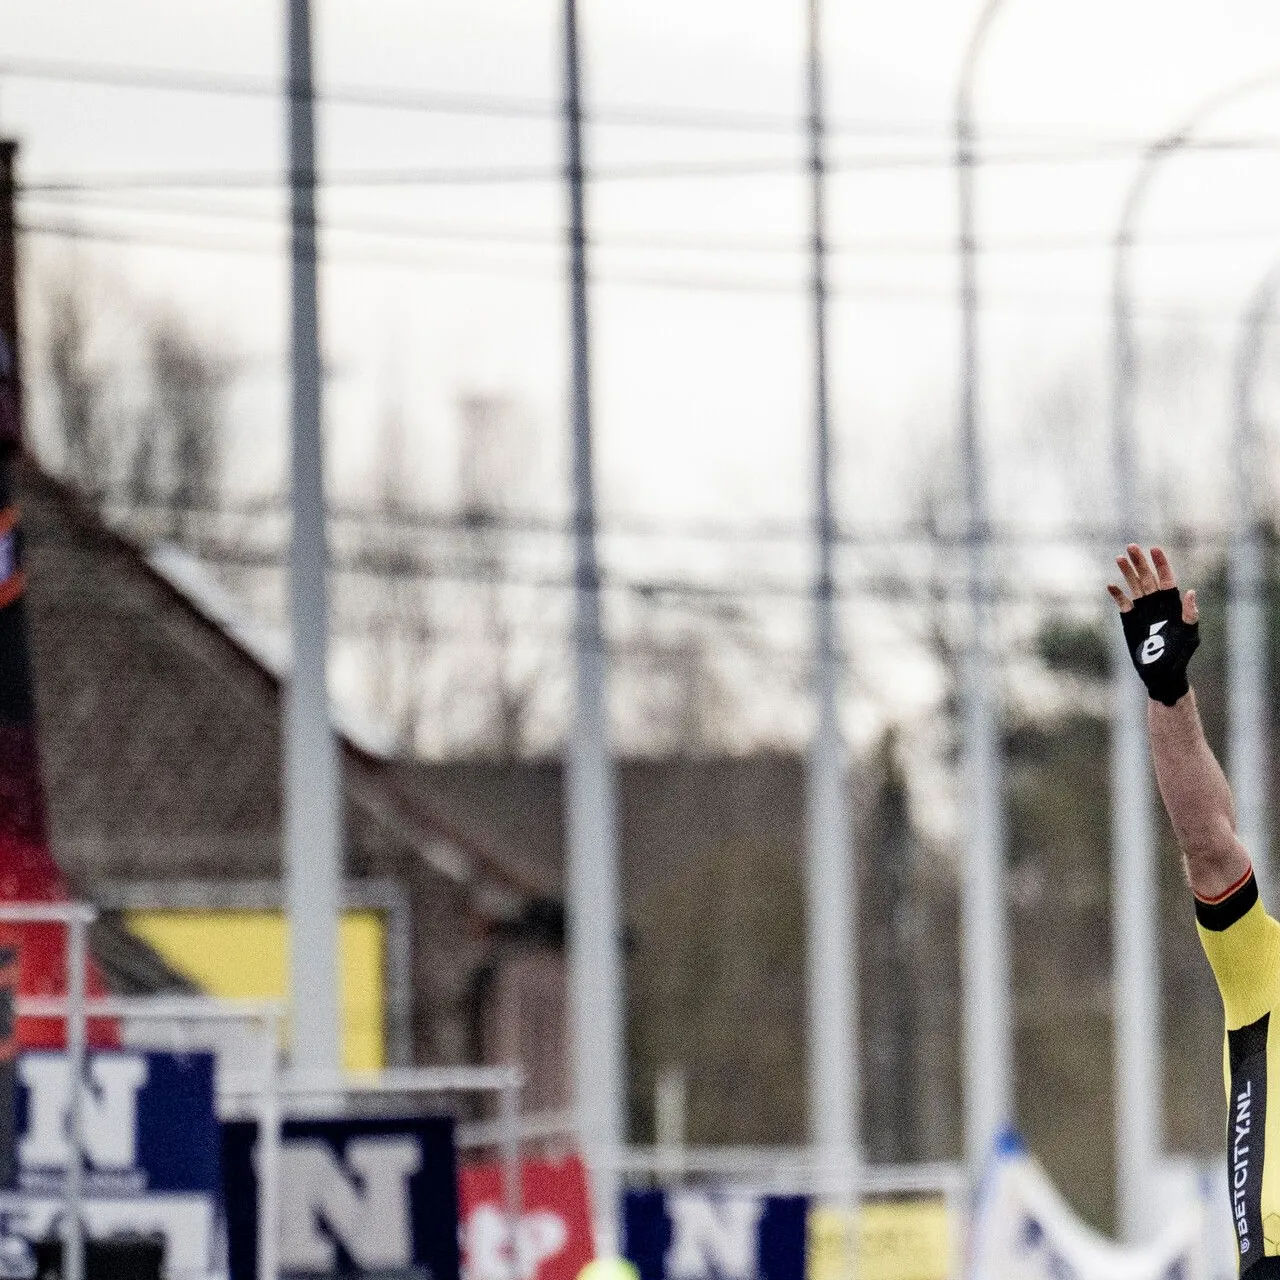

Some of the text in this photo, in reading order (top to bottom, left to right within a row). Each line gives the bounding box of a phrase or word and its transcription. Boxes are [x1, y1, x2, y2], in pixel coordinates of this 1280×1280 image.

[255, 1136, 423, 1273] N
[1234, 1080, 1252, 1236] BETCITY.NL
[664, 1192, 767, 1278] N
